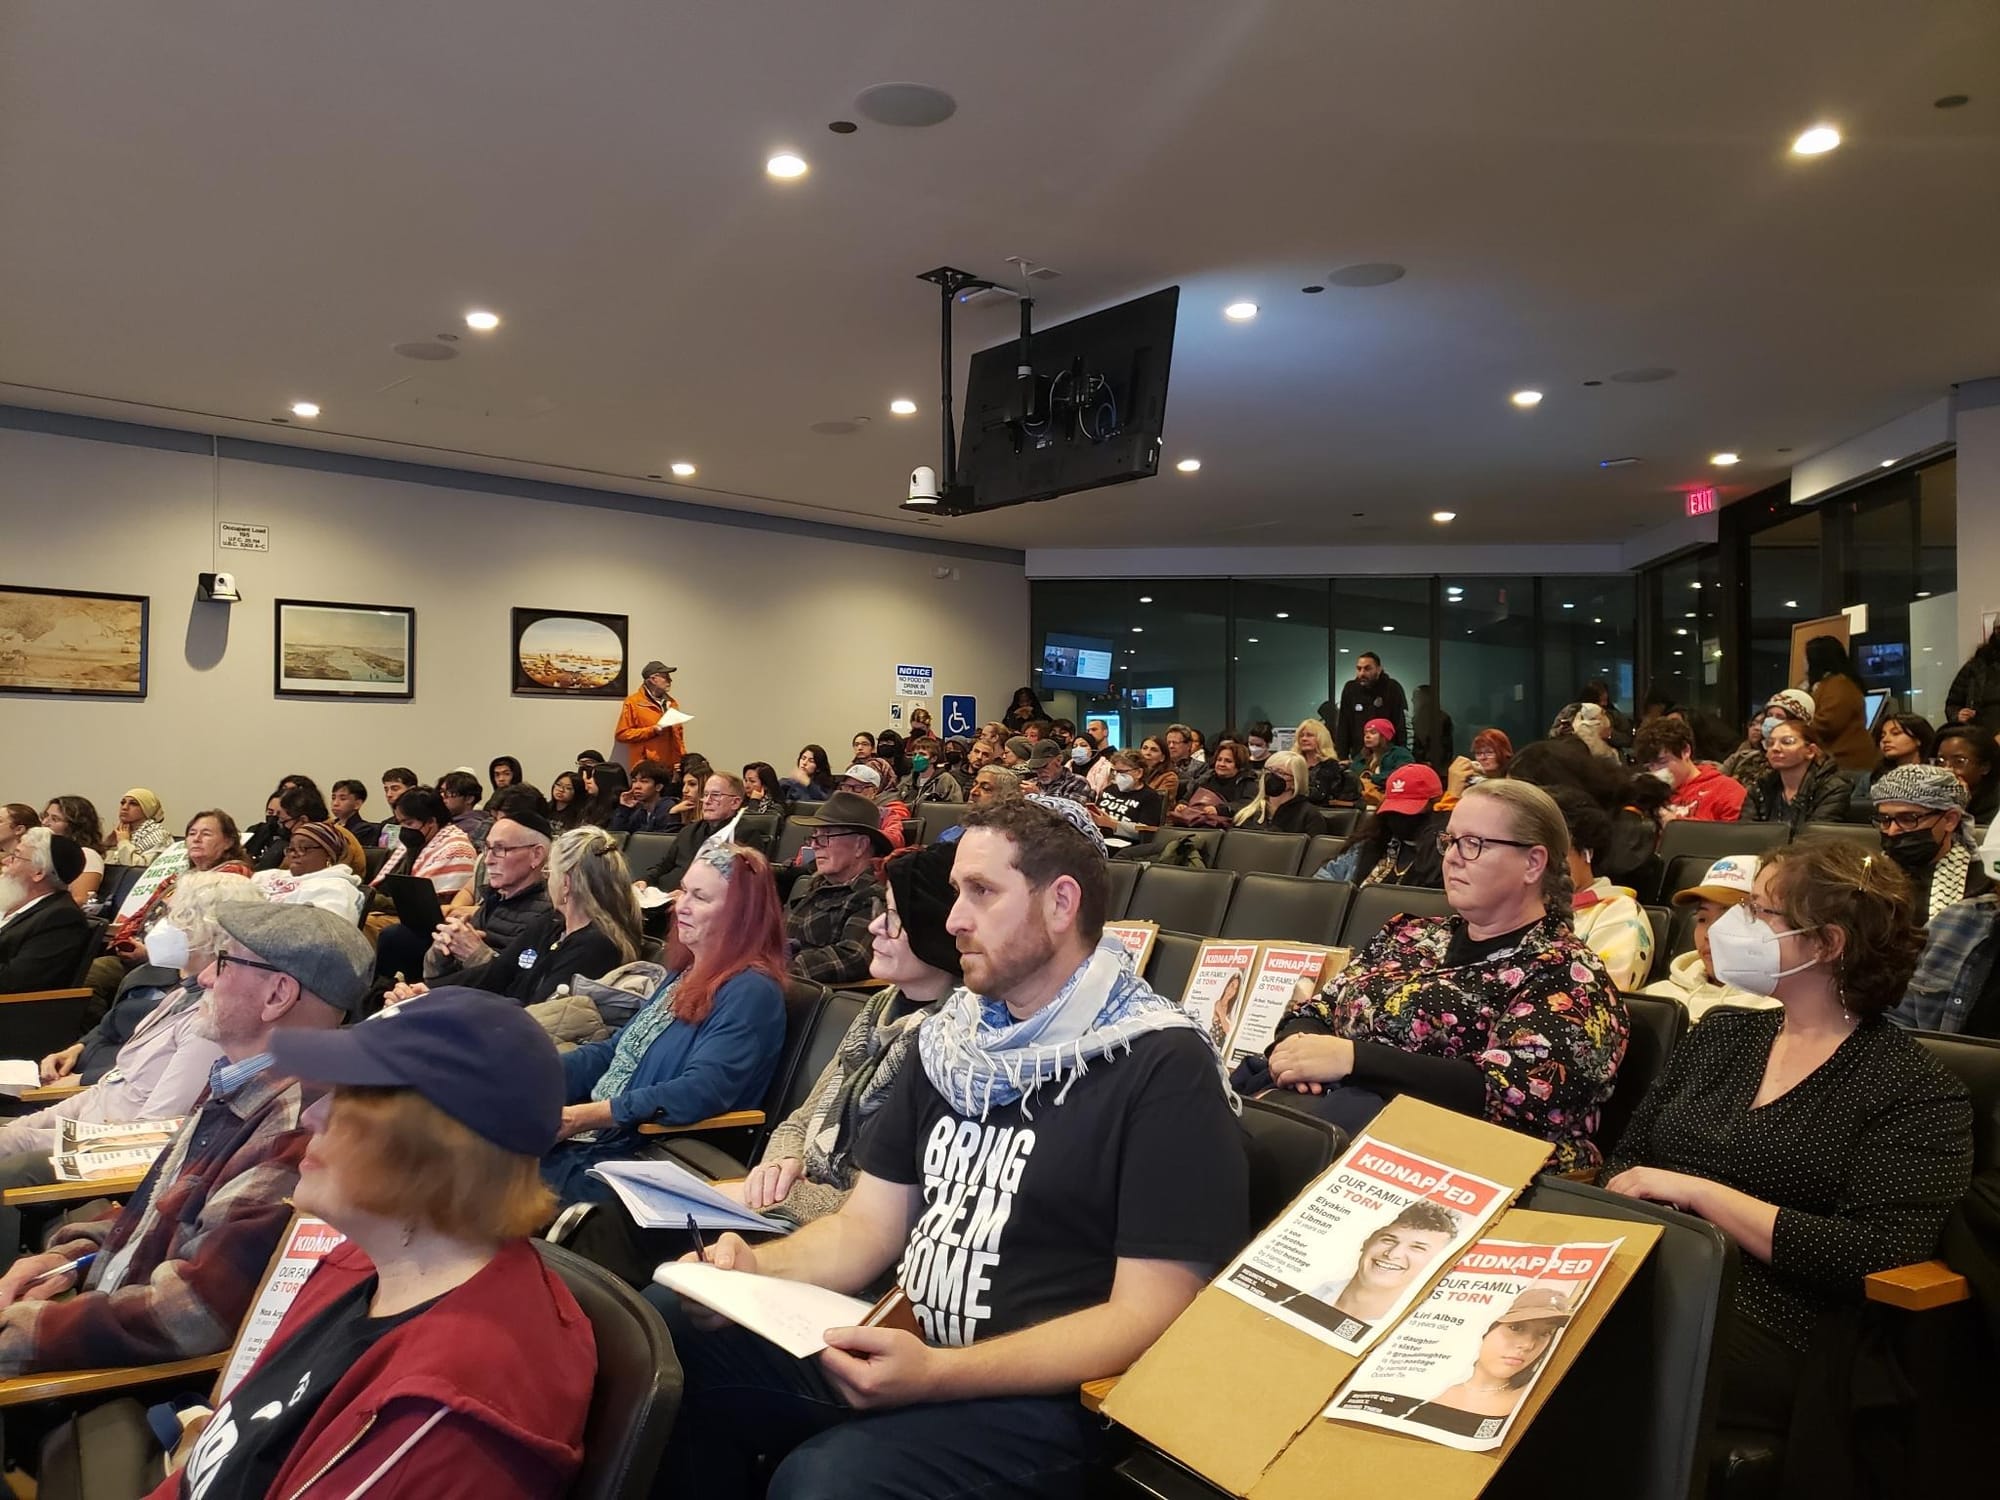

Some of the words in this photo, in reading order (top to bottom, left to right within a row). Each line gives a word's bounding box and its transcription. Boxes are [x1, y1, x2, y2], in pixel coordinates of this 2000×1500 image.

[1691, 490, 1712, 515] EXIT
[899, 668, 930, 676] NOTICE
[1100, 800, 1128, 814] OUR
[1124, 799, 1140, 808] IN
[1204, 953, 1248, 964] KIDNAPPED
[1200, 970, 1210, 978] OUR
[1262, 975, 1276, 983] OUR
[1276, 976, 1297, 985] FAMILY
[1266, 984, 1286, 992] TORN
[924, 1115, 1036, 1194] BRING
[1357, 1152, 1478, 1206] KIDNAPPED
[1326, 1183, 1342, 1196] IS
[1342, 1190, 1382, 1212] TORN
[1338, 1174, 1366, 1194] OUR
[1366, 1184, 1414, 1208] FAMILY
[918, 1174, 1012, 1252] THEM
[1308, 1204, 1341, 1222] Shlomo
[1315, 1196, 1352, 1216] Elyakim
[1300, 1212, 1332, 1229] Libman
[1276, 1241, 1308, 1256] grandson
[1282, 1235, 1308, 1248] brother
[1282, 1252, 1310, 1268] hostage
[1460, 1252, 1593, 1275] KIDNAPPED
[279, 1266, 296, 1278] OUR
[271, 1281, 281, 1292] IS
[1438, 1278, 1472, 1290] OUR
[1472, 1280, 1527, 1295] FAMILY
[1448, 1292, 1494, 1305] TORN
[1413, 1311, 1433, 1320] Liri
[1433, 1313, 1465, 1326] Albag
[1418, 1321, 1436, 1329] years
[1403, 1336, 1440, 1344] daughter
